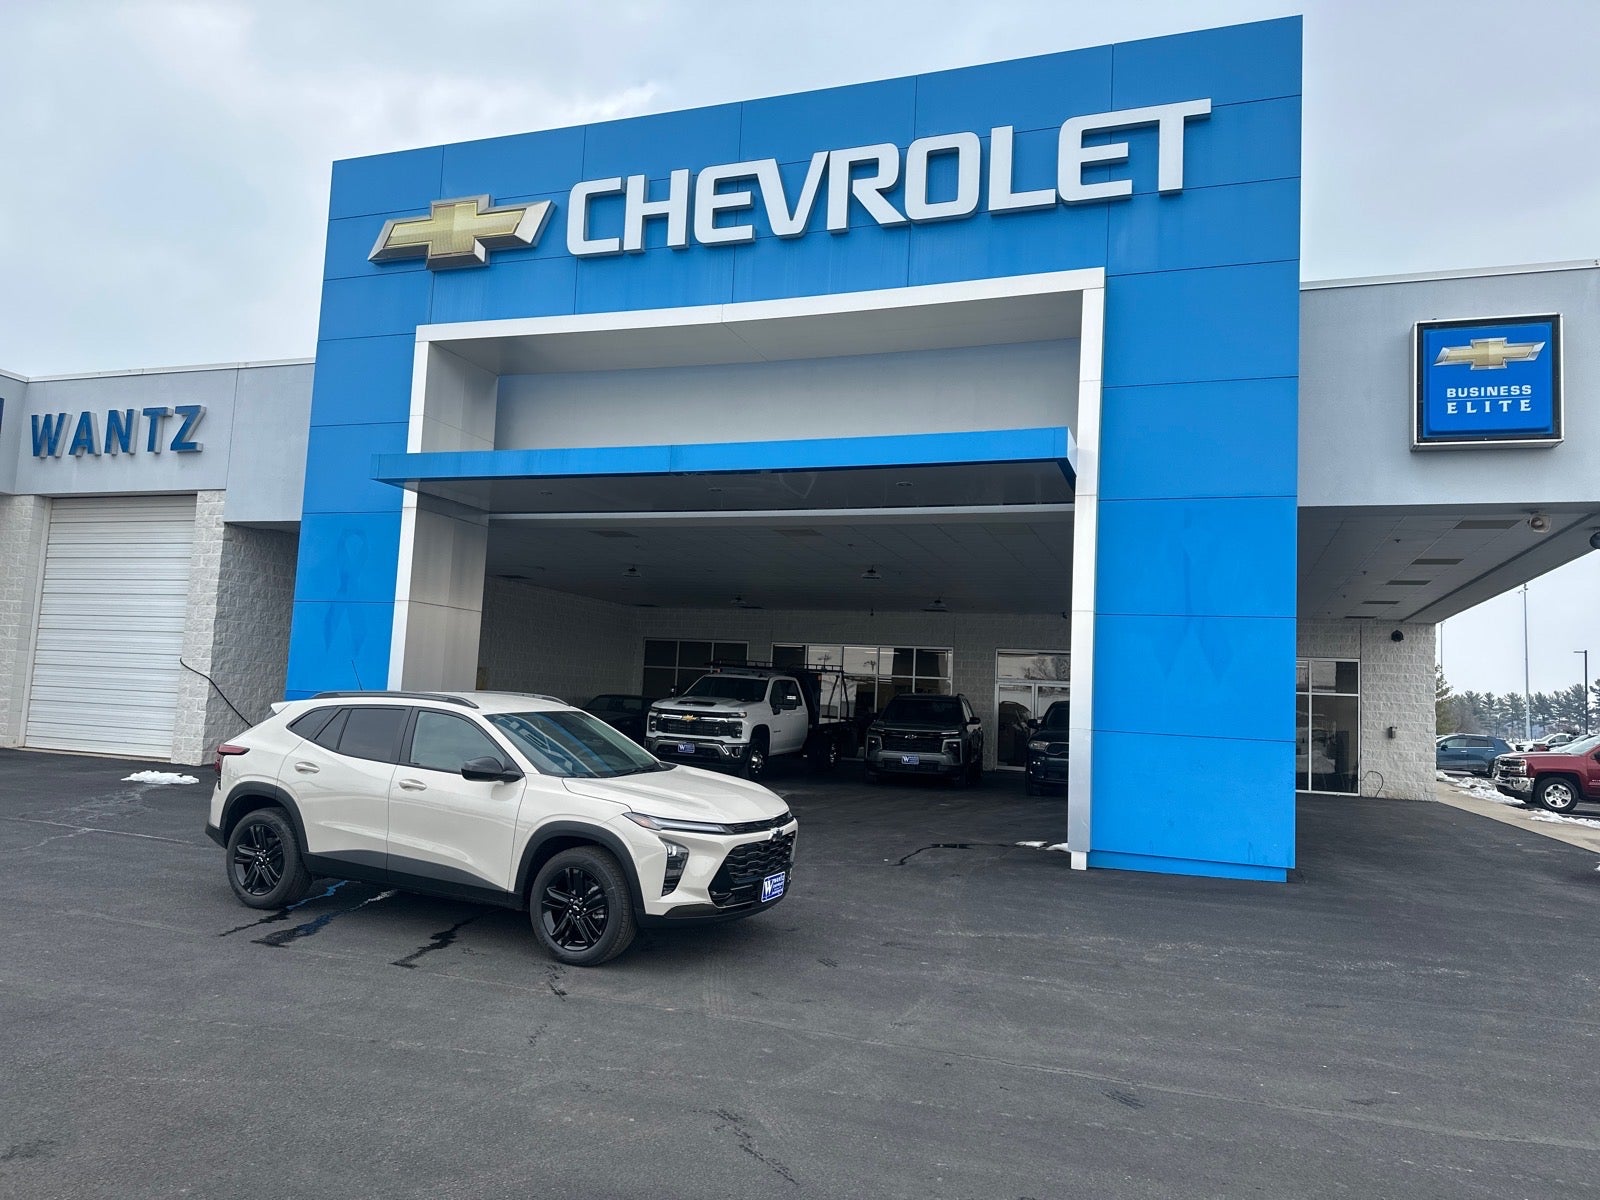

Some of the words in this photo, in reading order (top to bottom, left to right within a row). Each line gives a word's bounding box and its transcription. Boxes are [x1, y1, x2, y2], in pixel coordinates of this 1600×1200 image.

[566, 98, 1212, 258] CHEVROLET
[1446, 384, 1532, 398] BUSINESS
[1447, 399, 1532, 414] ELITE
[31, 404, 207, 459] WANTZ
